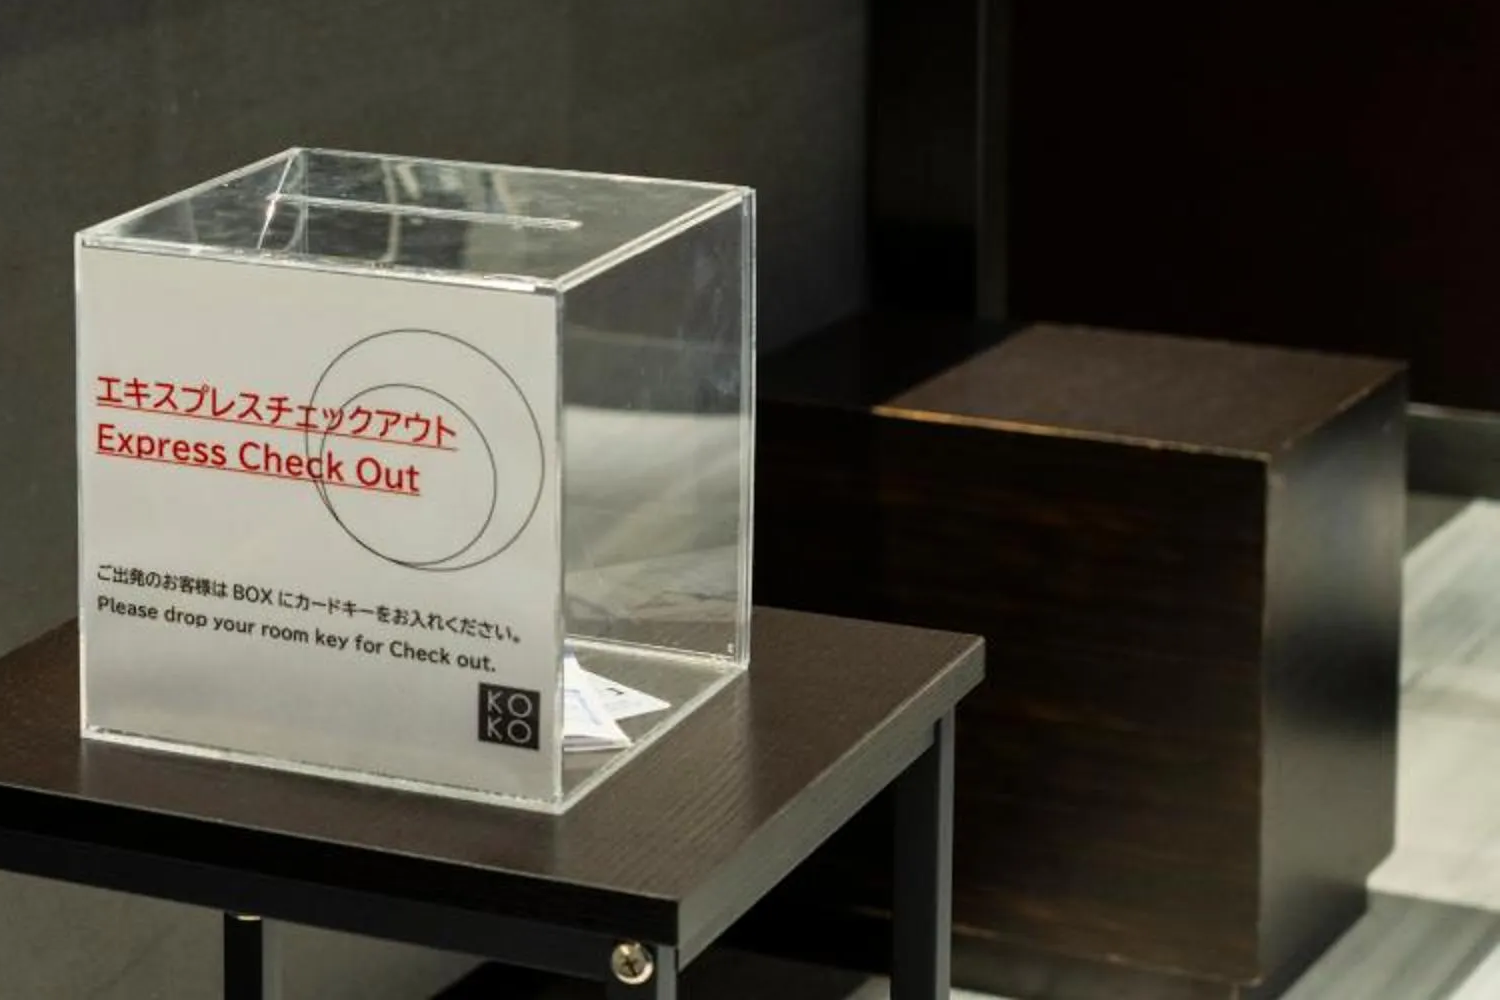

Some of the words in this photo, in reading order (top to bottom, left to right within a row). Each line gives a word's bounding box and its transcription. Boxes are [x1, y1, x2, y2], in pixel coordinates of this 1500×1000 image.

[97, 376, 457, 447] エキスプレスチェックアウト
[98, 424, 227, 466] Express
[239, 441, 345, 482] Check
[355, 457, 420, 493] Out
[233, 583, 273, 606] BOX
[97, 596, 159, 620] Please
[164, 604, 208, 628] drop
[213, 615, 255, 637] your
[261, 624, 310, 643] room
[315, 630, 349, 651] key
[355, 635, 384, 655] for
[389, 641, 451, 666] Check
[457, 652, 497, 673] out.
[486, 690, 533, 719] KO
[486, 716, 533, 745] KO
